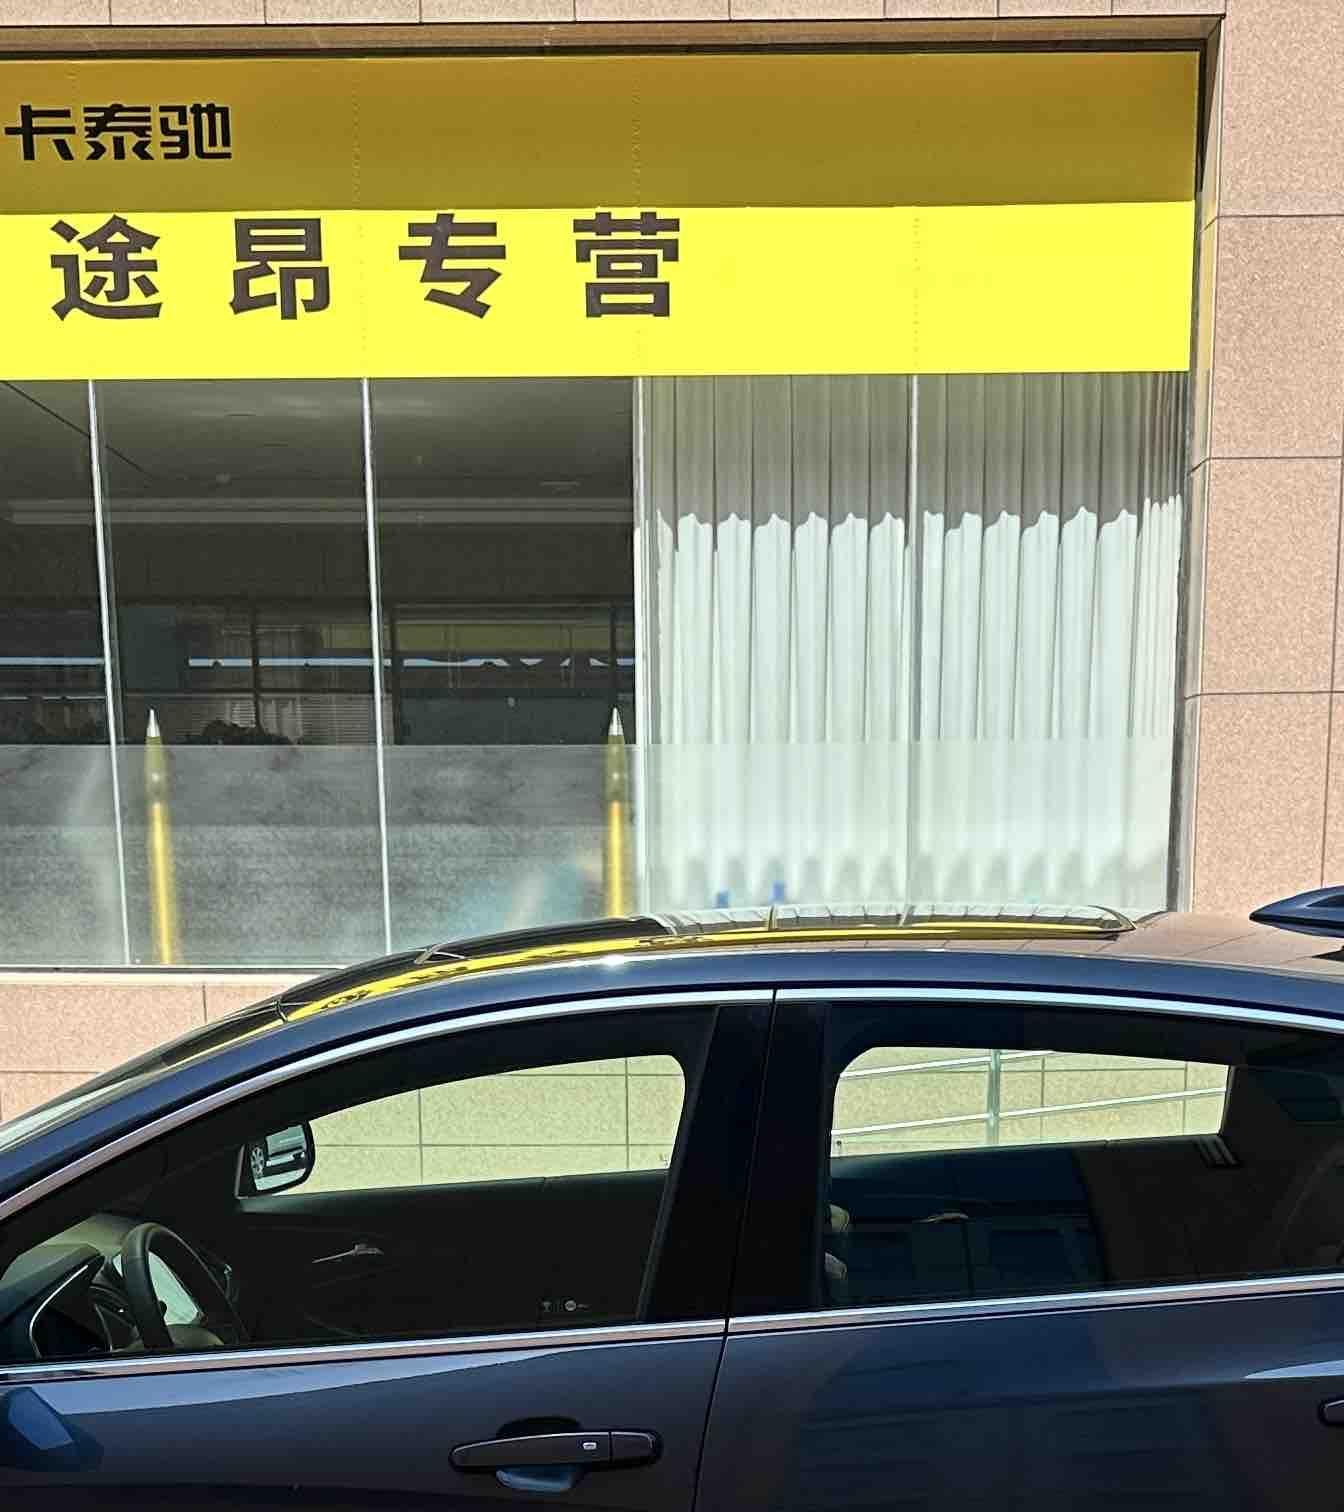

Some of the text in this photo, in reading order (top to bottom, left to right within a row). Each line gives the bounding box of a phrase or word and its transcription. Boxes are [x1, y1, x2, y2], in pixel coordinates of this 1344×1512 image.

[4, 102, 232, 161] 卡泰驰
[50, 211, 681, 321] 途昂专营
